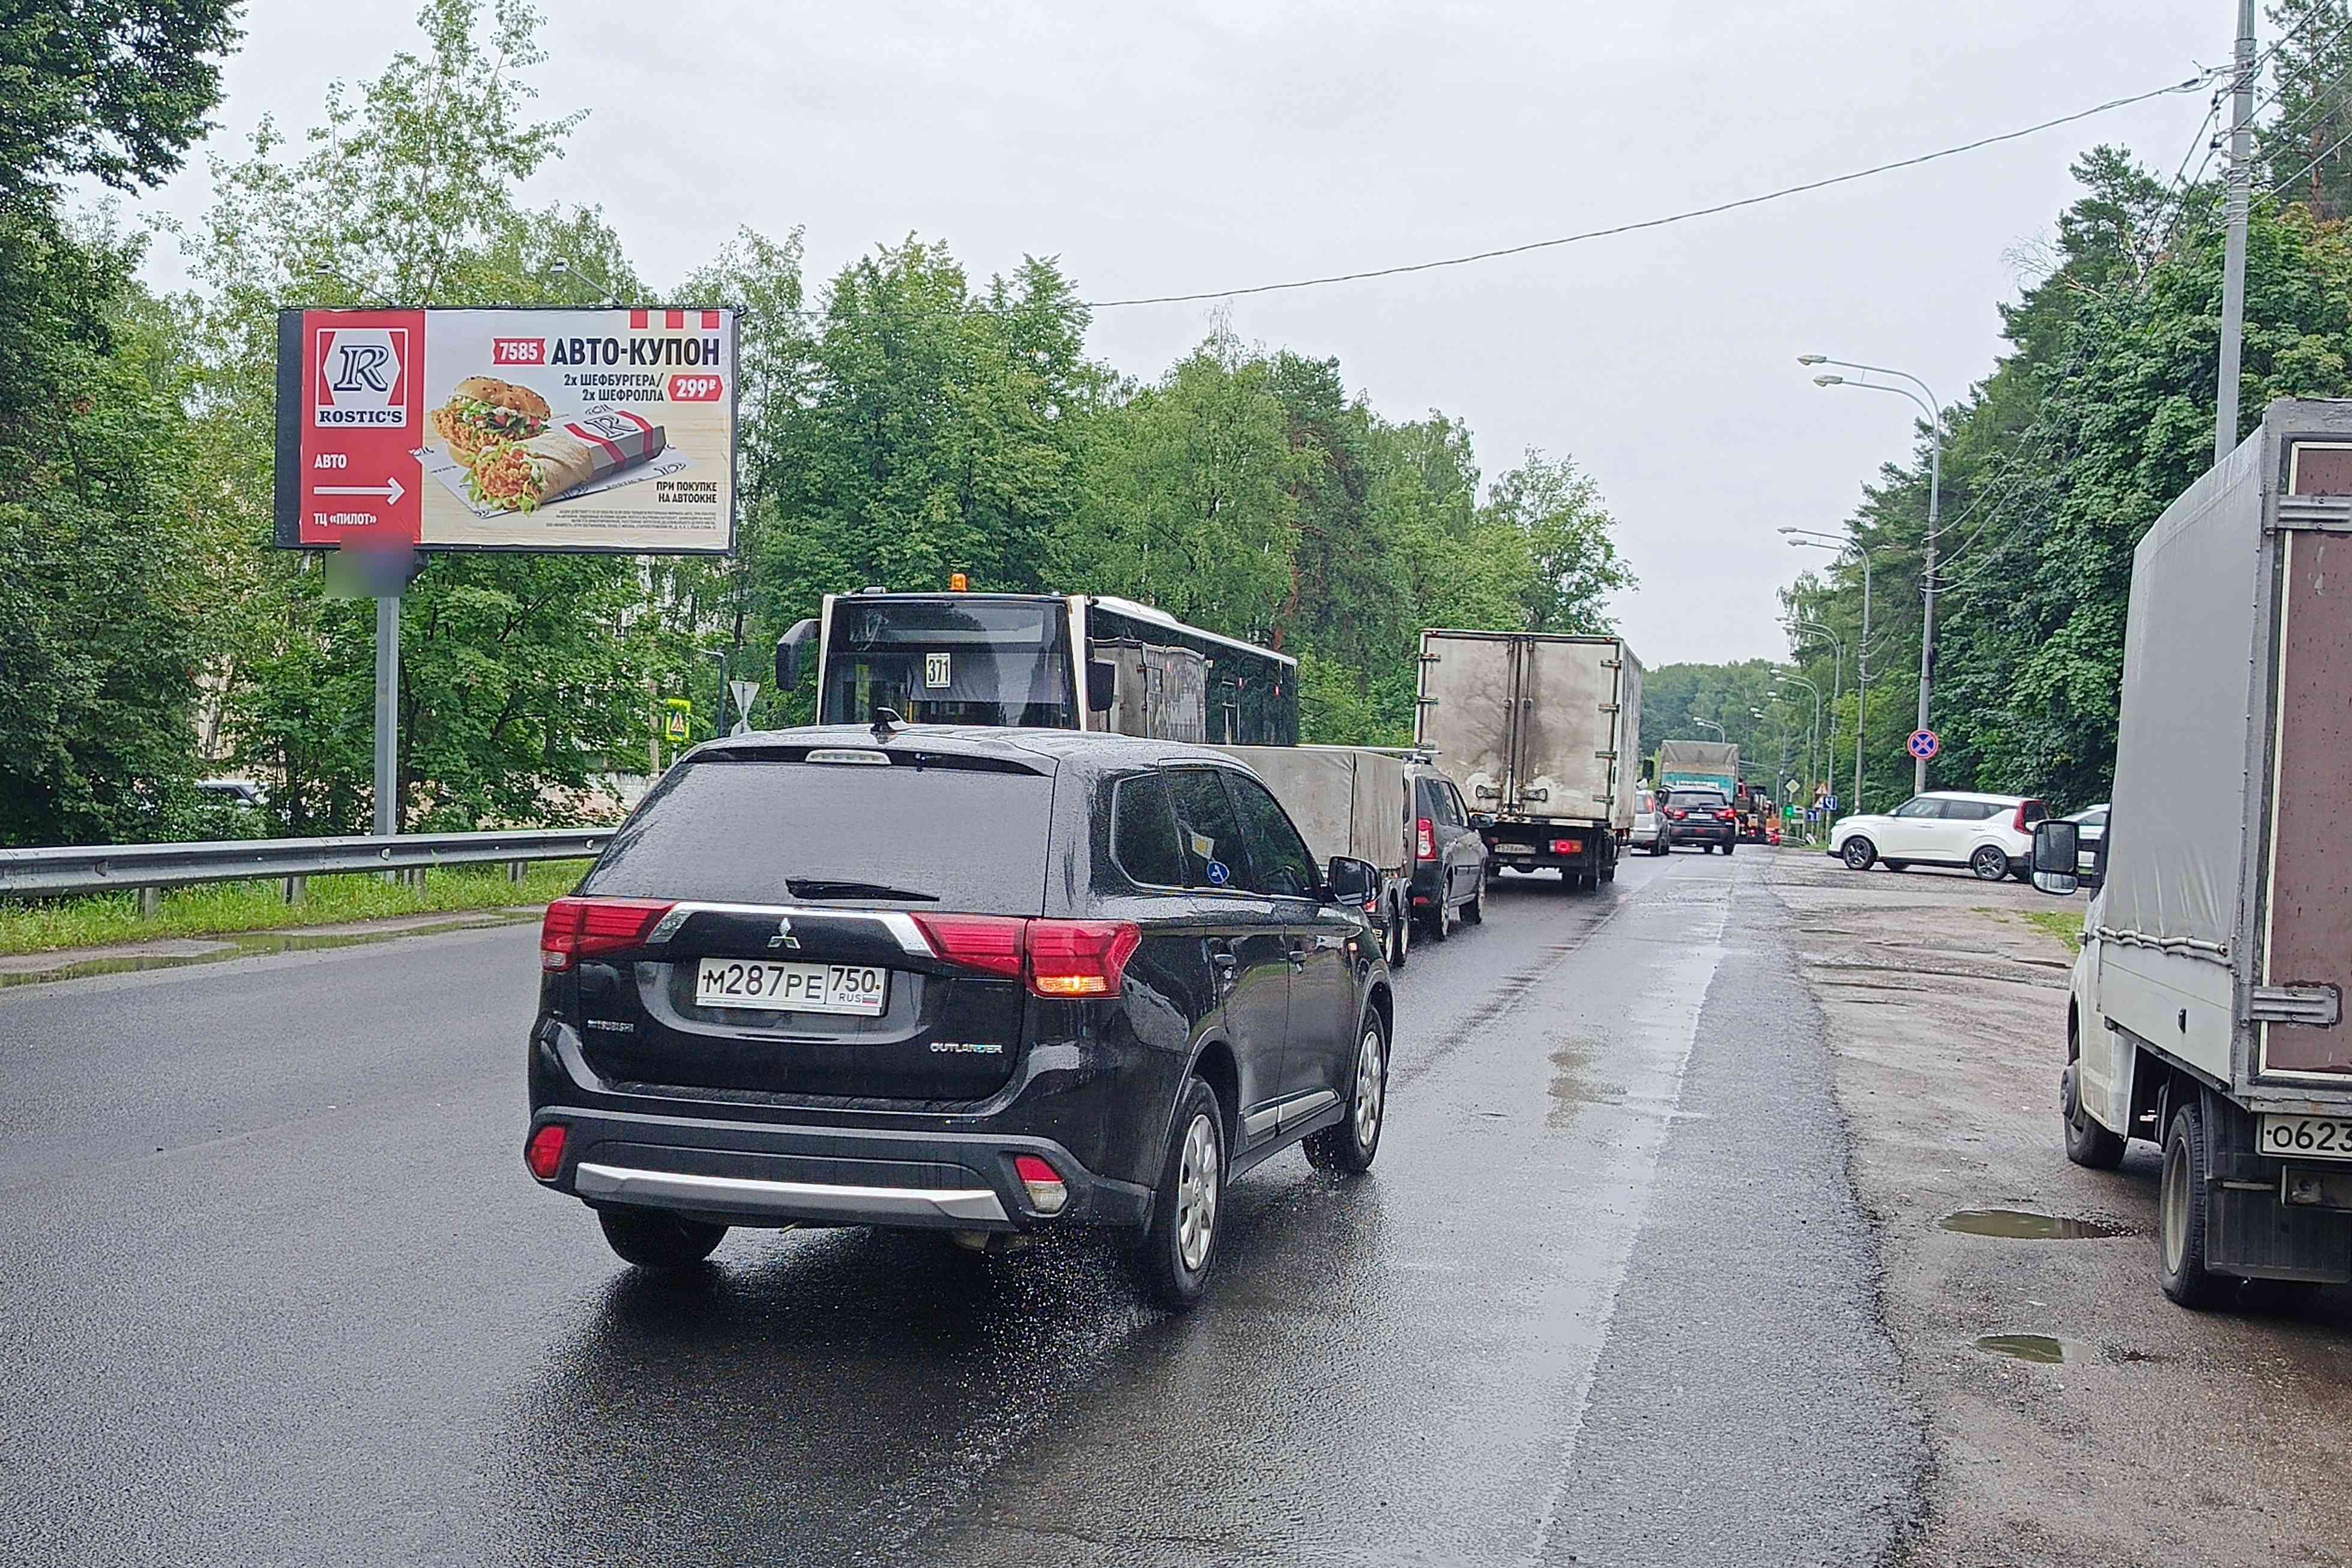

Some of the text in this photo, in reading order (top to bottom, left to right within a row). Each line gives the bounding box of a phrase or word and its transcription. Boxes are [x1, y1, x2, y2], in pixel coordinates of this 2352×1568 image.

[499, 338, 720, 366] 7585 АВТО-КУПОН
[334, 346, 389, 391] R
[580, 373, 664, 387] ШЕФБУРГЕРА/
[599, 389, 665, 402] ШЕФРОЛЛА
[319, 411, 403, 423] ROSTIC'S
[314, 453, 348, 469] АВТО
[656, 481, 675, 491] ПРИ
[677, 481, 717, 492] ПОКУПКЕ
[658, 493, 717, 504] НА АВТООКНЕ
[313, 513, 377, 526] ТЦ «ПИЛОТ»
[928, 659, 948, 683] 371
[705, 963, 876, 1000] М287РЕ 750
[839, 993, 862, 1003] RUS
